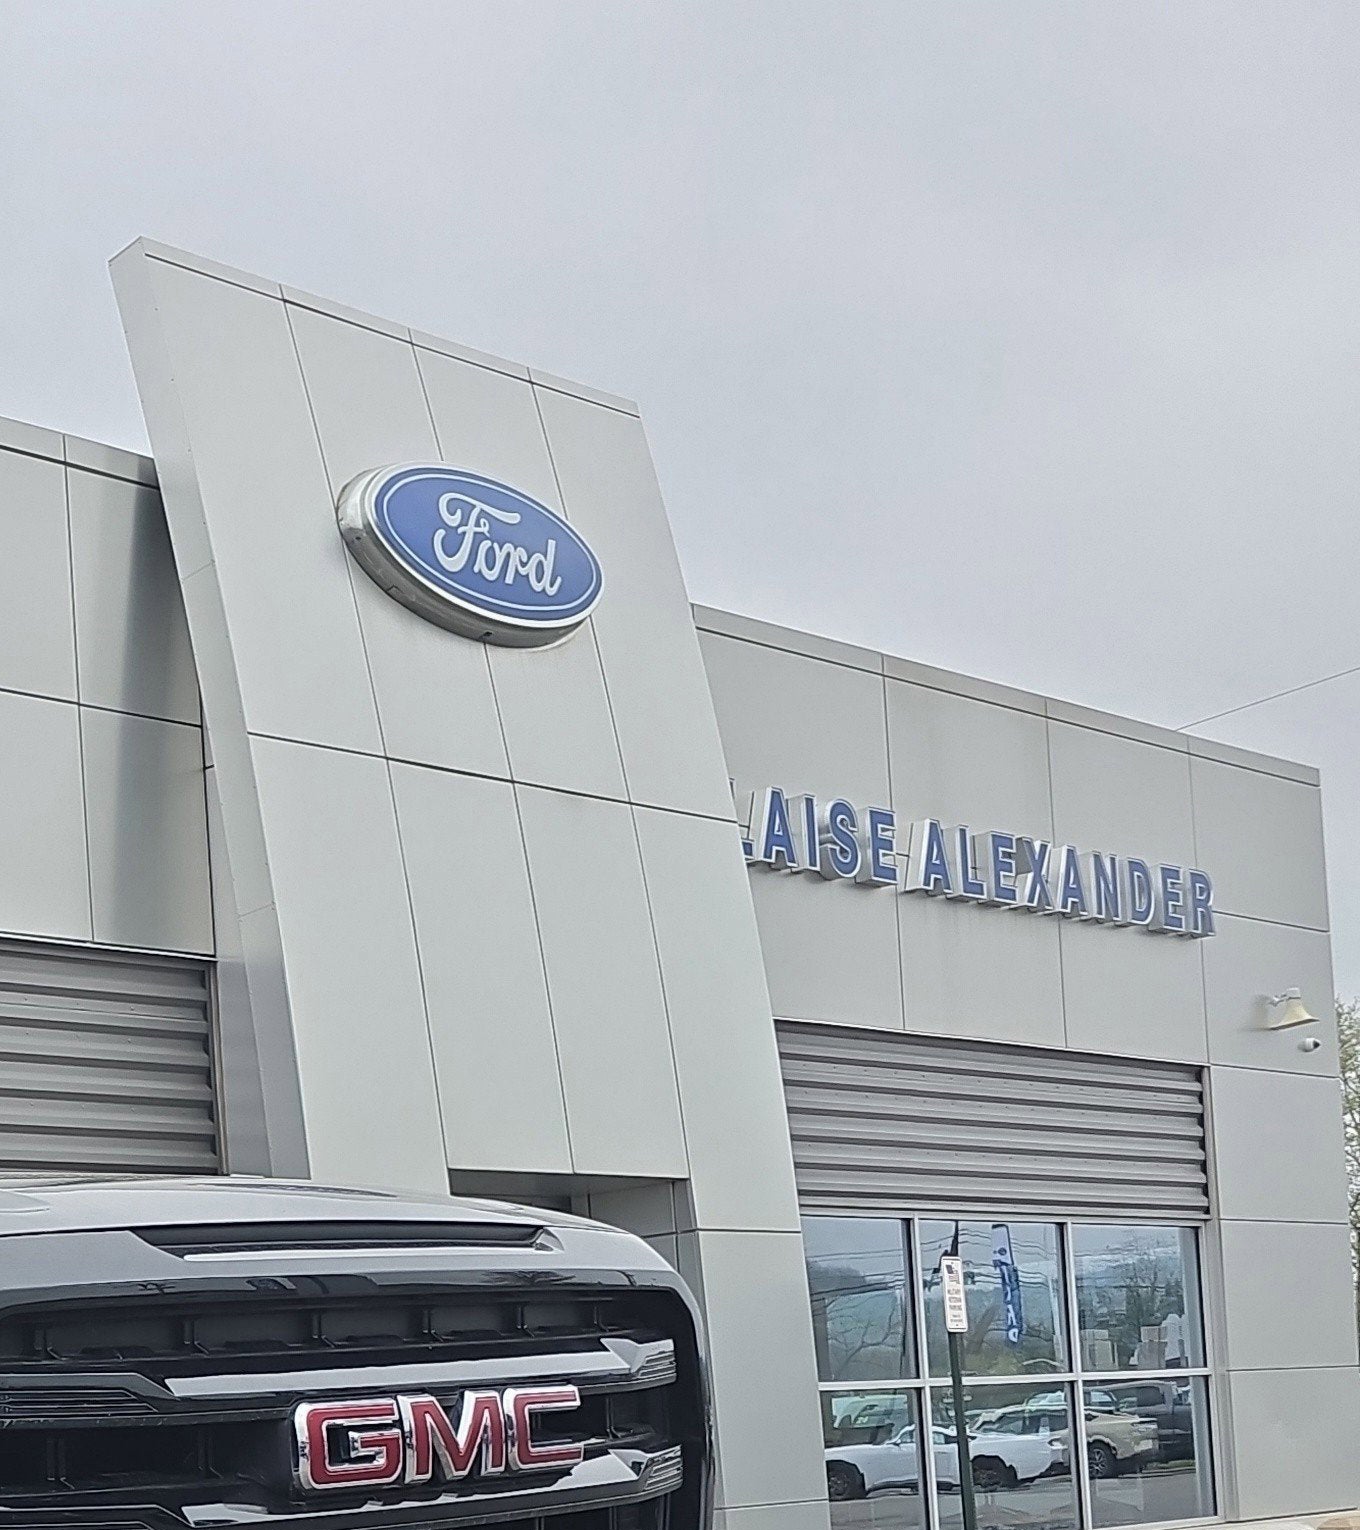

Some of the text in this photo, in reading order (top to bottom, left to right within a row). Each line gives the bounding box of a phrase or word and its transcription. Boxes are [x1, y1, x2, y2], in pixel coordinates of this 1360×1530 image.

[431, 491, 563, 597] Ford
[730, 778, 1217, 938] AISE ALEXANDER
[294, 1384, 585, 1491] GMC
